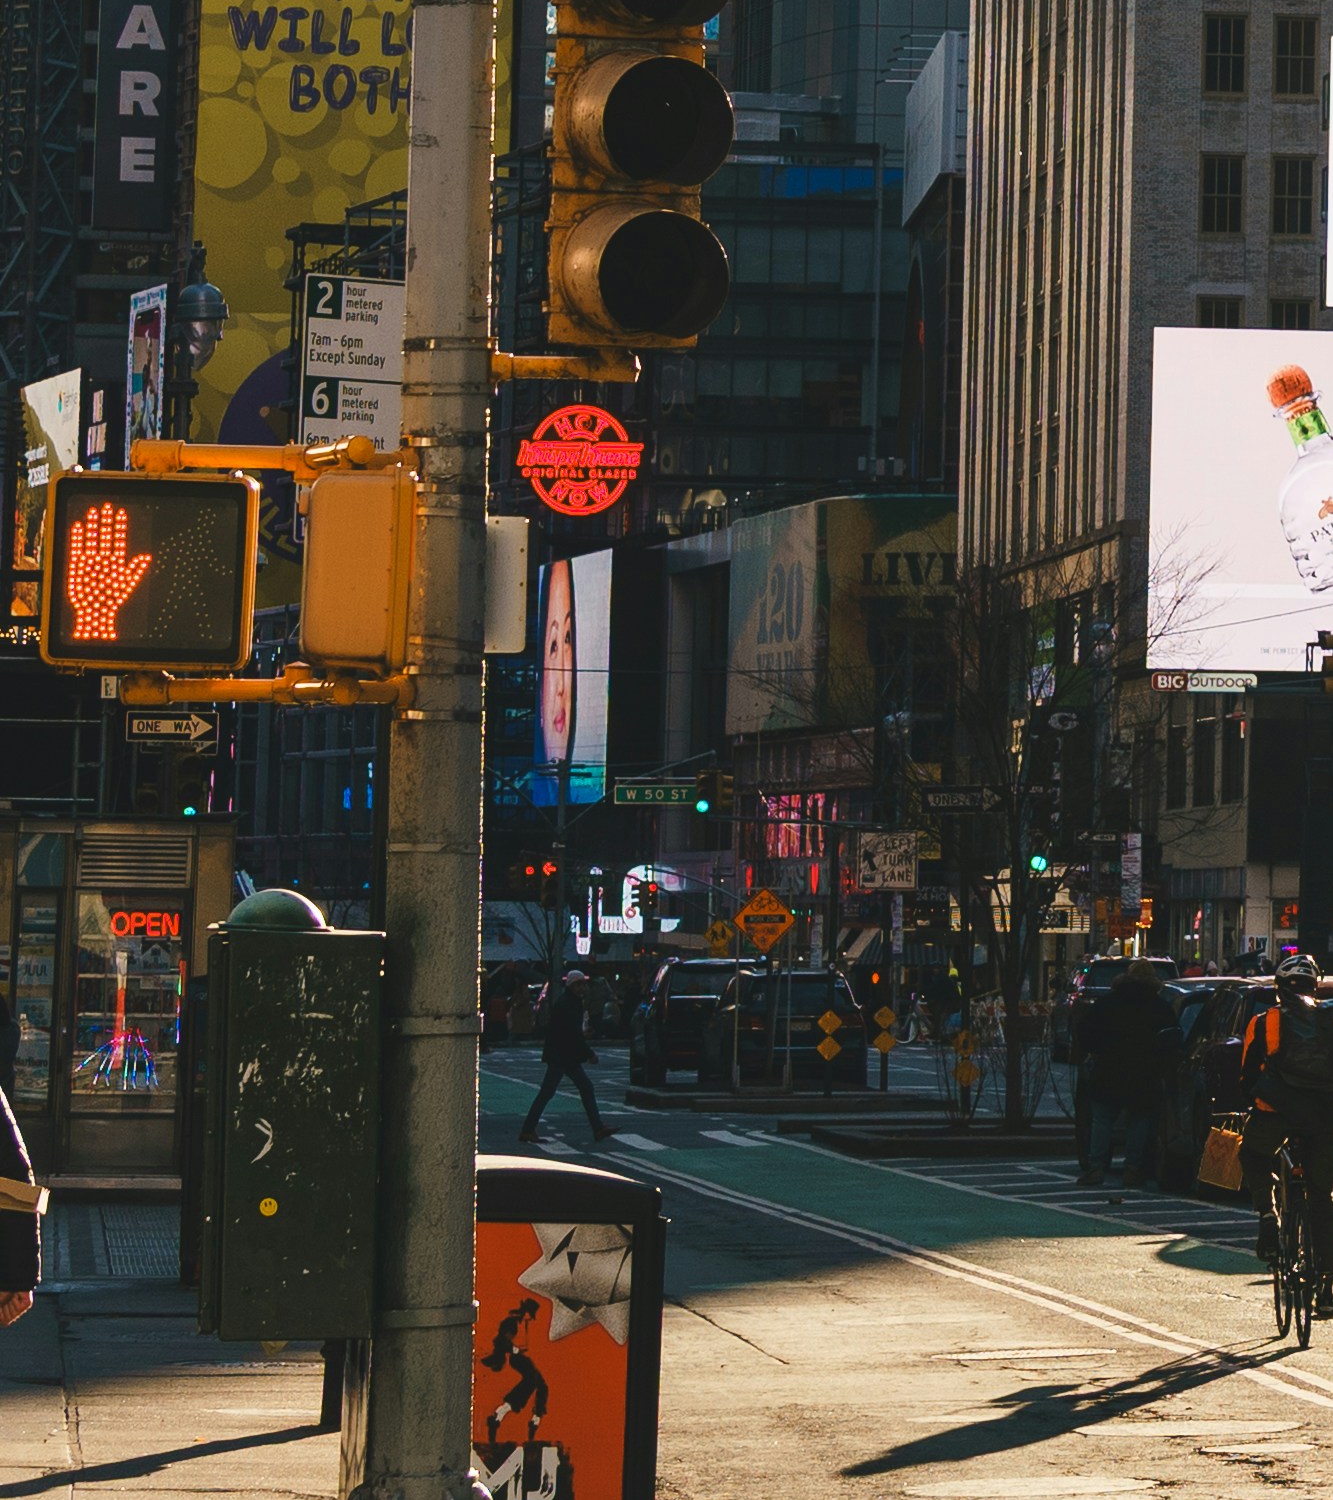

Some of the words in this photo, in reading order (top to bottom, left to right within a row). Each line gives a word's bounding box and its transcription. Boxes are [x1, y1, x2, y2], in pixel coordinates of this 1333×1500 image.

[228, 5, 360, 57] WILL
[316, 281, 334, 315] 2
[346, 284, 367, 298] hour
[345, 299, 383, 312] metered
[345, 311, 380, 326] parking
[310, 332, 332, 346] 7am
[340, 335, 364, 351] 6pm
[309, 348, 345, 366] Except
[347, 351, 386, 370] Sunday
[311, 381, 330, 416] 6
[342, 384, 363, 397] hour
[341, 397, 379, 411] metered
[341, 411, 375, 425] parking
[553, 413, 610, 438] HOT
[521, 466, 585, 479] ORIGINAL
[588, 468, 637, 480] GLAZED
[549, 480, 609, 507] NOW
[756, 561, 804, 645] 120
[1156, 675, 1186, 689] BIG
[1190, 675, 1254, 689] OUTDOOR
[136, 720, 162, 733] ONE
[173, 720, 200, 733] WAY
[626, 788, 637, 800] W
[645, 788, 665, 801] 50
[671, 788, 688, 801] ST
[882, 838, 913, 850] LEFT
[882, 854, 913, 866] TURN
[881, 870, 912, 883] LANE
[110, 911, 181, 937] OPEN
